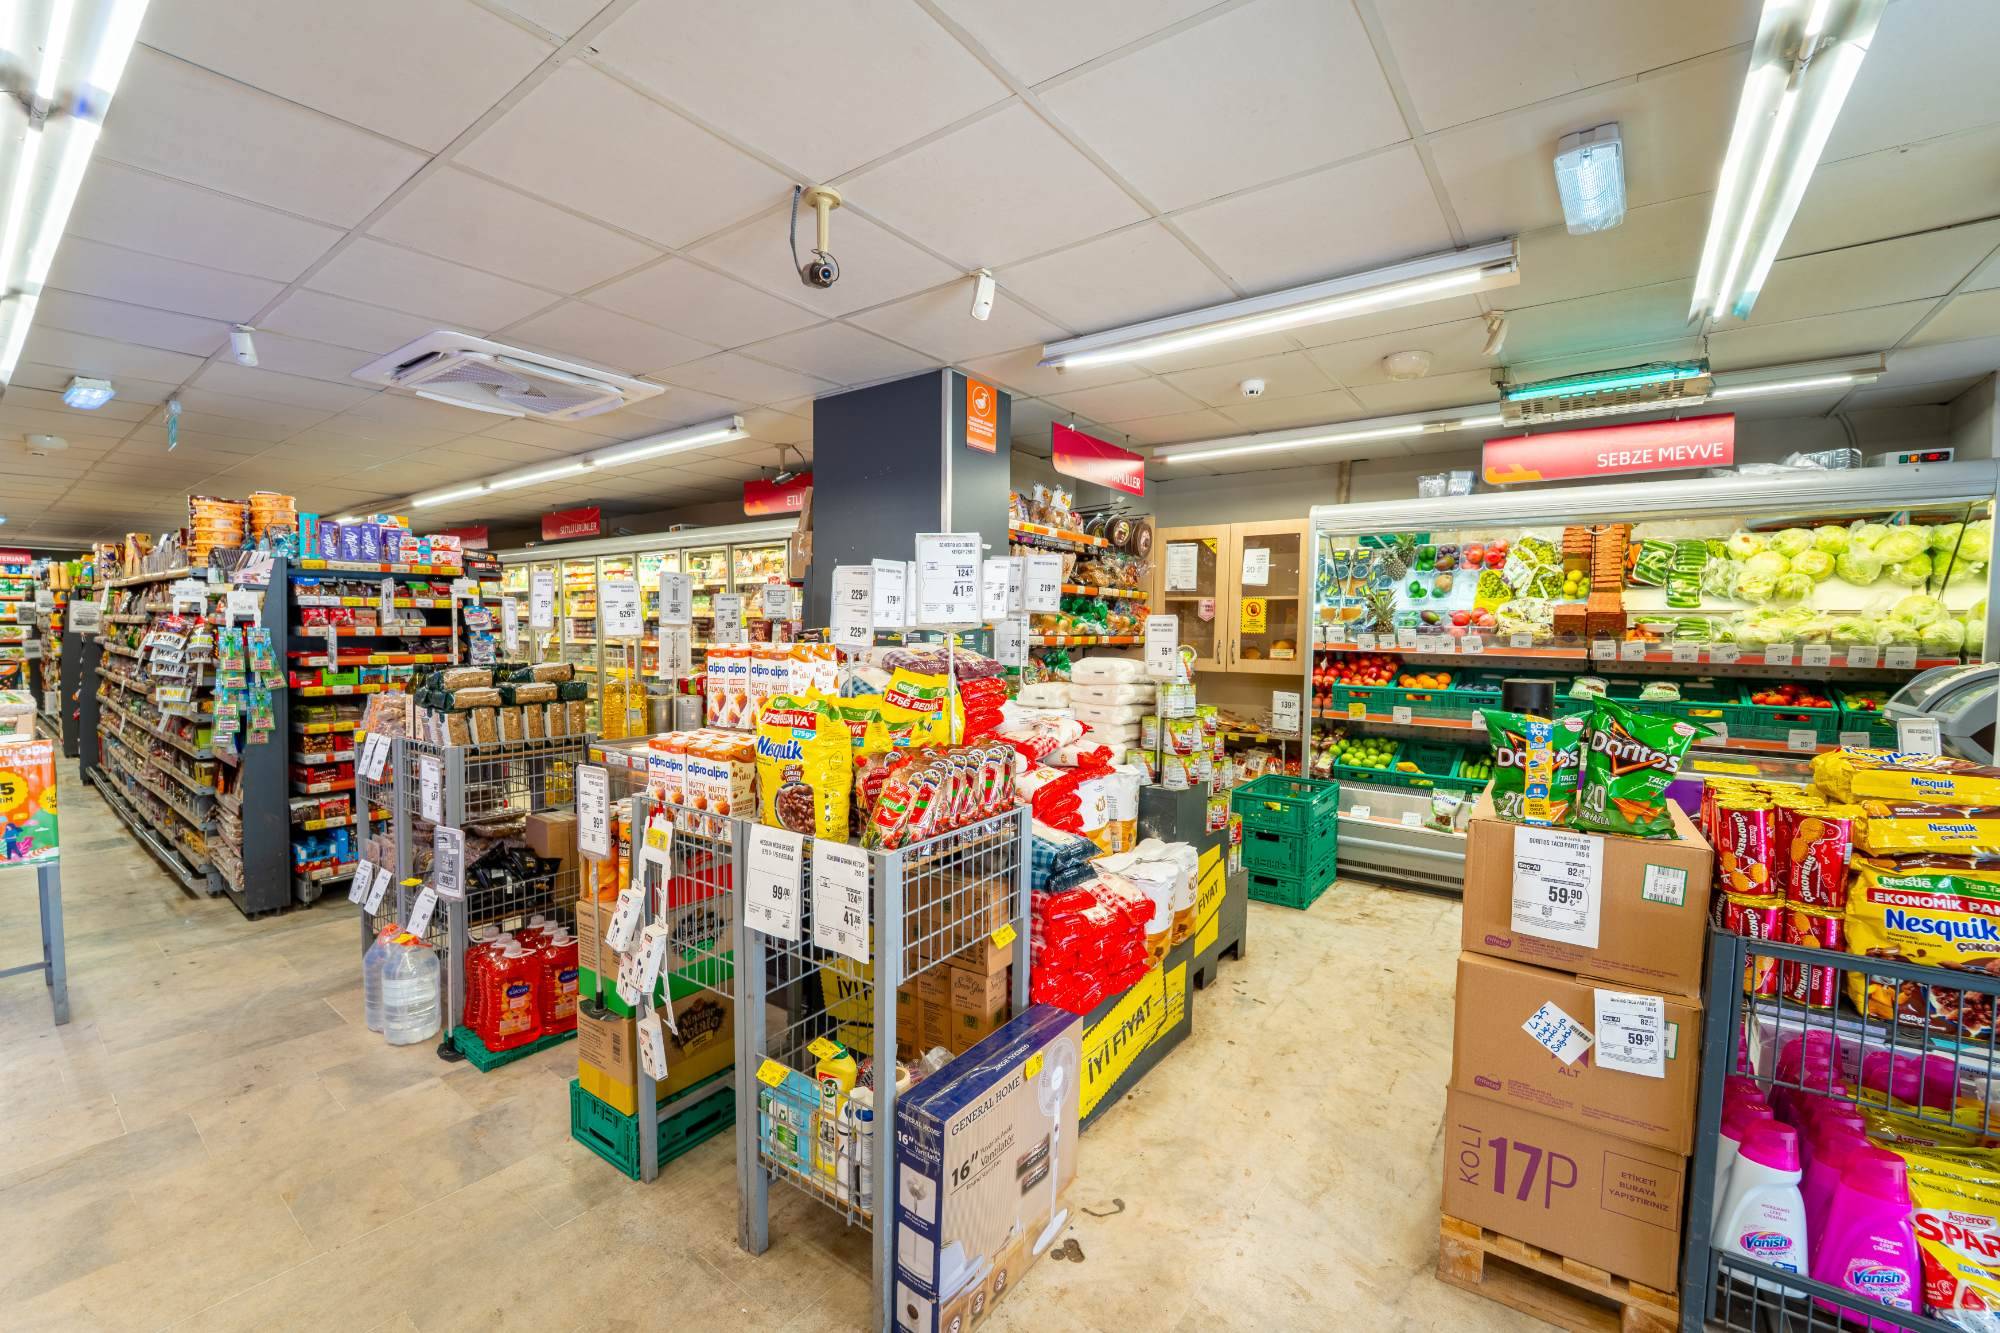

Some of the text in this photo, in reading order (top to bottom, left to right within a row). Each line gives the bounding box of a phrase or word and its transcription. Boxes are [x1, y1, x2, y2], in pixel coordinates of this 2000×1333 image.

[1597, 442, 1724, 468] SEBZE MEYVE
[708, 662, 726, 675] alpro
[728, 662, 746, 675] alpro
[752, 663, 769, 676] alpro
[770, 665, 789, 679] alpro
[758, 735, 803, 763] Nesquik
[1592, 731, 1680, 773] Doritos
[665, 758, 683, 771] alpro
[688, 763, 707, 776] alpro
[707, 766, 729, 780] alpro
[1648, 776, 1671, 787] TACO
[1911, 778, 1955, 789] Nesquik
[708, 785, 727, 796] NUTTY
[1732, 811, 1747, 858] ÇOKOPRENS
[1928, 823, 1977, 834] Nesquik
[1801, 855, 1816, 903] ÇOKOPRENS
[1964, 881, 1987, 891] Tam
[1197, 880, 1221, 914] FİYAT
[1548, 885, 1583, 904] 59,90
[1874, 891, 1964, 911] EKONOMİK
[1885, 909, 2000, 942] Nesquik
[1088, 995, 1152, 1084] İYİ FİYAT
[1628, 1032, 1654, 1046] 59,90
[1558, 1066, 1581, 1078] ALT
[951, 1077, 1021, 1136] GENERAL HOME
[1895, 1135, 1938, 1147] Asperox
[1458, 1123, 1578, 1209] KOLİ 17P
[1618, 1181, 1657, 1198] BURAYA
[1947, 1211, 1991, 1228] Asperox
[1746, 1236, 1788, 1249] Vanish
[1853, 1272, 1901, 1285] Vanish
